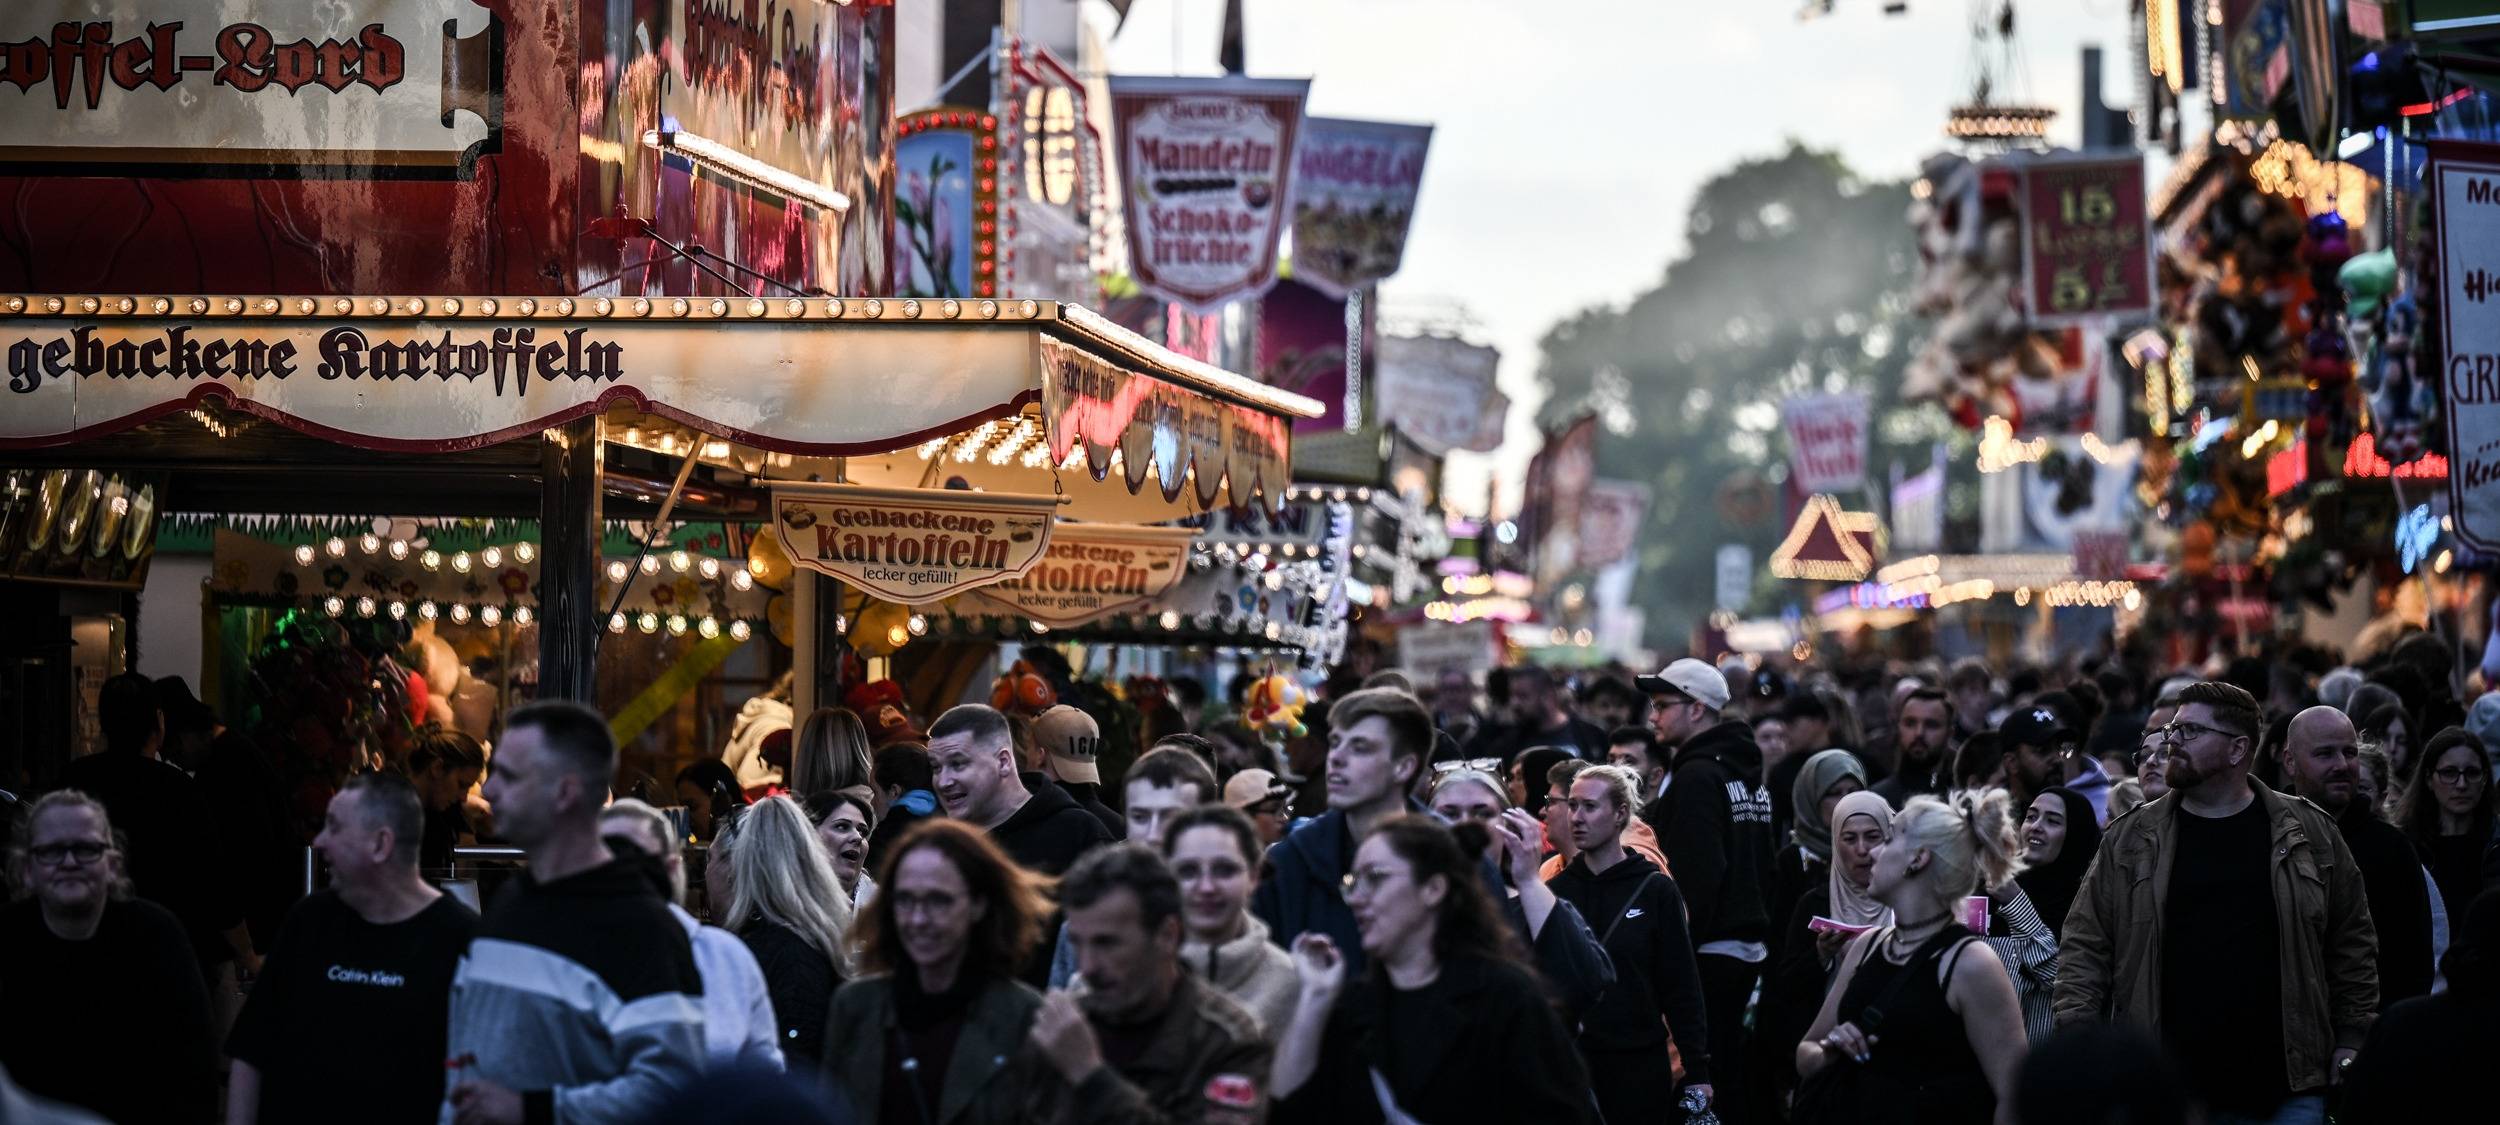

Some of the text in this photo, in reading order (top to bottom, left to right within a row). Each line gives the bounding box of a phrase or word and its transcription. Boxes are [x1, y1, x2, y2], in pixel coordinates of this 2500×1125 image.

[0, 21, 405, 110] offel-Lord
[1136, 137, 1273, 172] Mandeln
[1150, 206, 1264, 234] Schoko-
[2060, 187, 2116, 225] 15
[9, 325, 624, 397] gebackene Kartoffeln
[832, 508, 995, 535] Gebackene
[815, 524, 1010, 571] Kartoffeln
[863, 566, 958, 586] lecker gefüllt!
[997, 562, 1149, 595] rtoffeln
[1018, 593, 1103, 610] lecker gefüllt!
[371, 970, 405, 987] Klein
